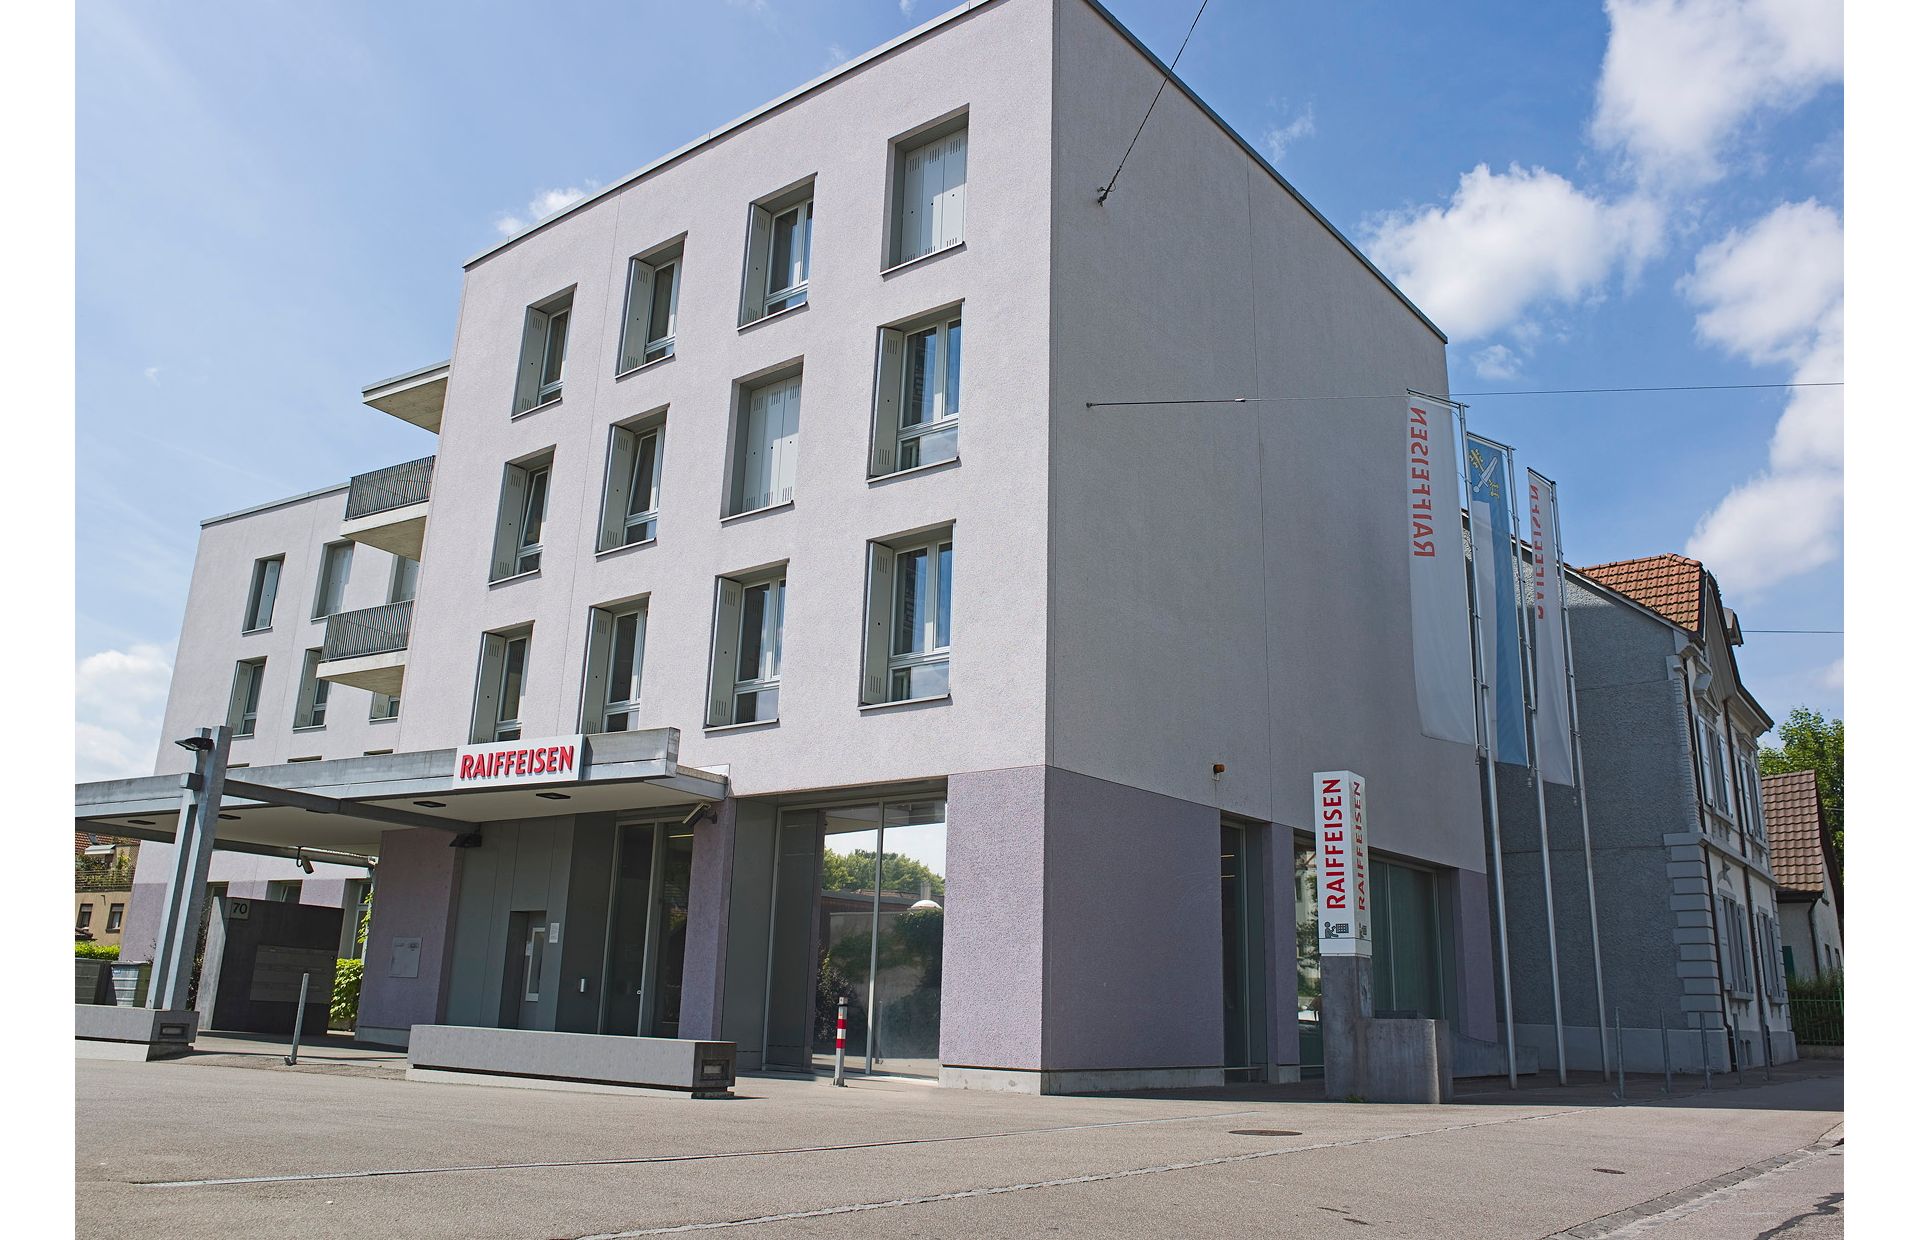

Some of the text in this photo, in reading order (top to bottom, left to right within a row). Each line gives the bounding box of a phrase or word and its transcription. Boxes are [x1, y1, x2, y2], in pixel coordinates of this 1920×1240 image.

[460, 745, 574, 779] RAIFFEISEN
[1322, 779, 1346, 909] RAIFFEISEN
[1353, 781, 1366, 911] RAIFFEISEN
[232, 903, 248, 915] 70
